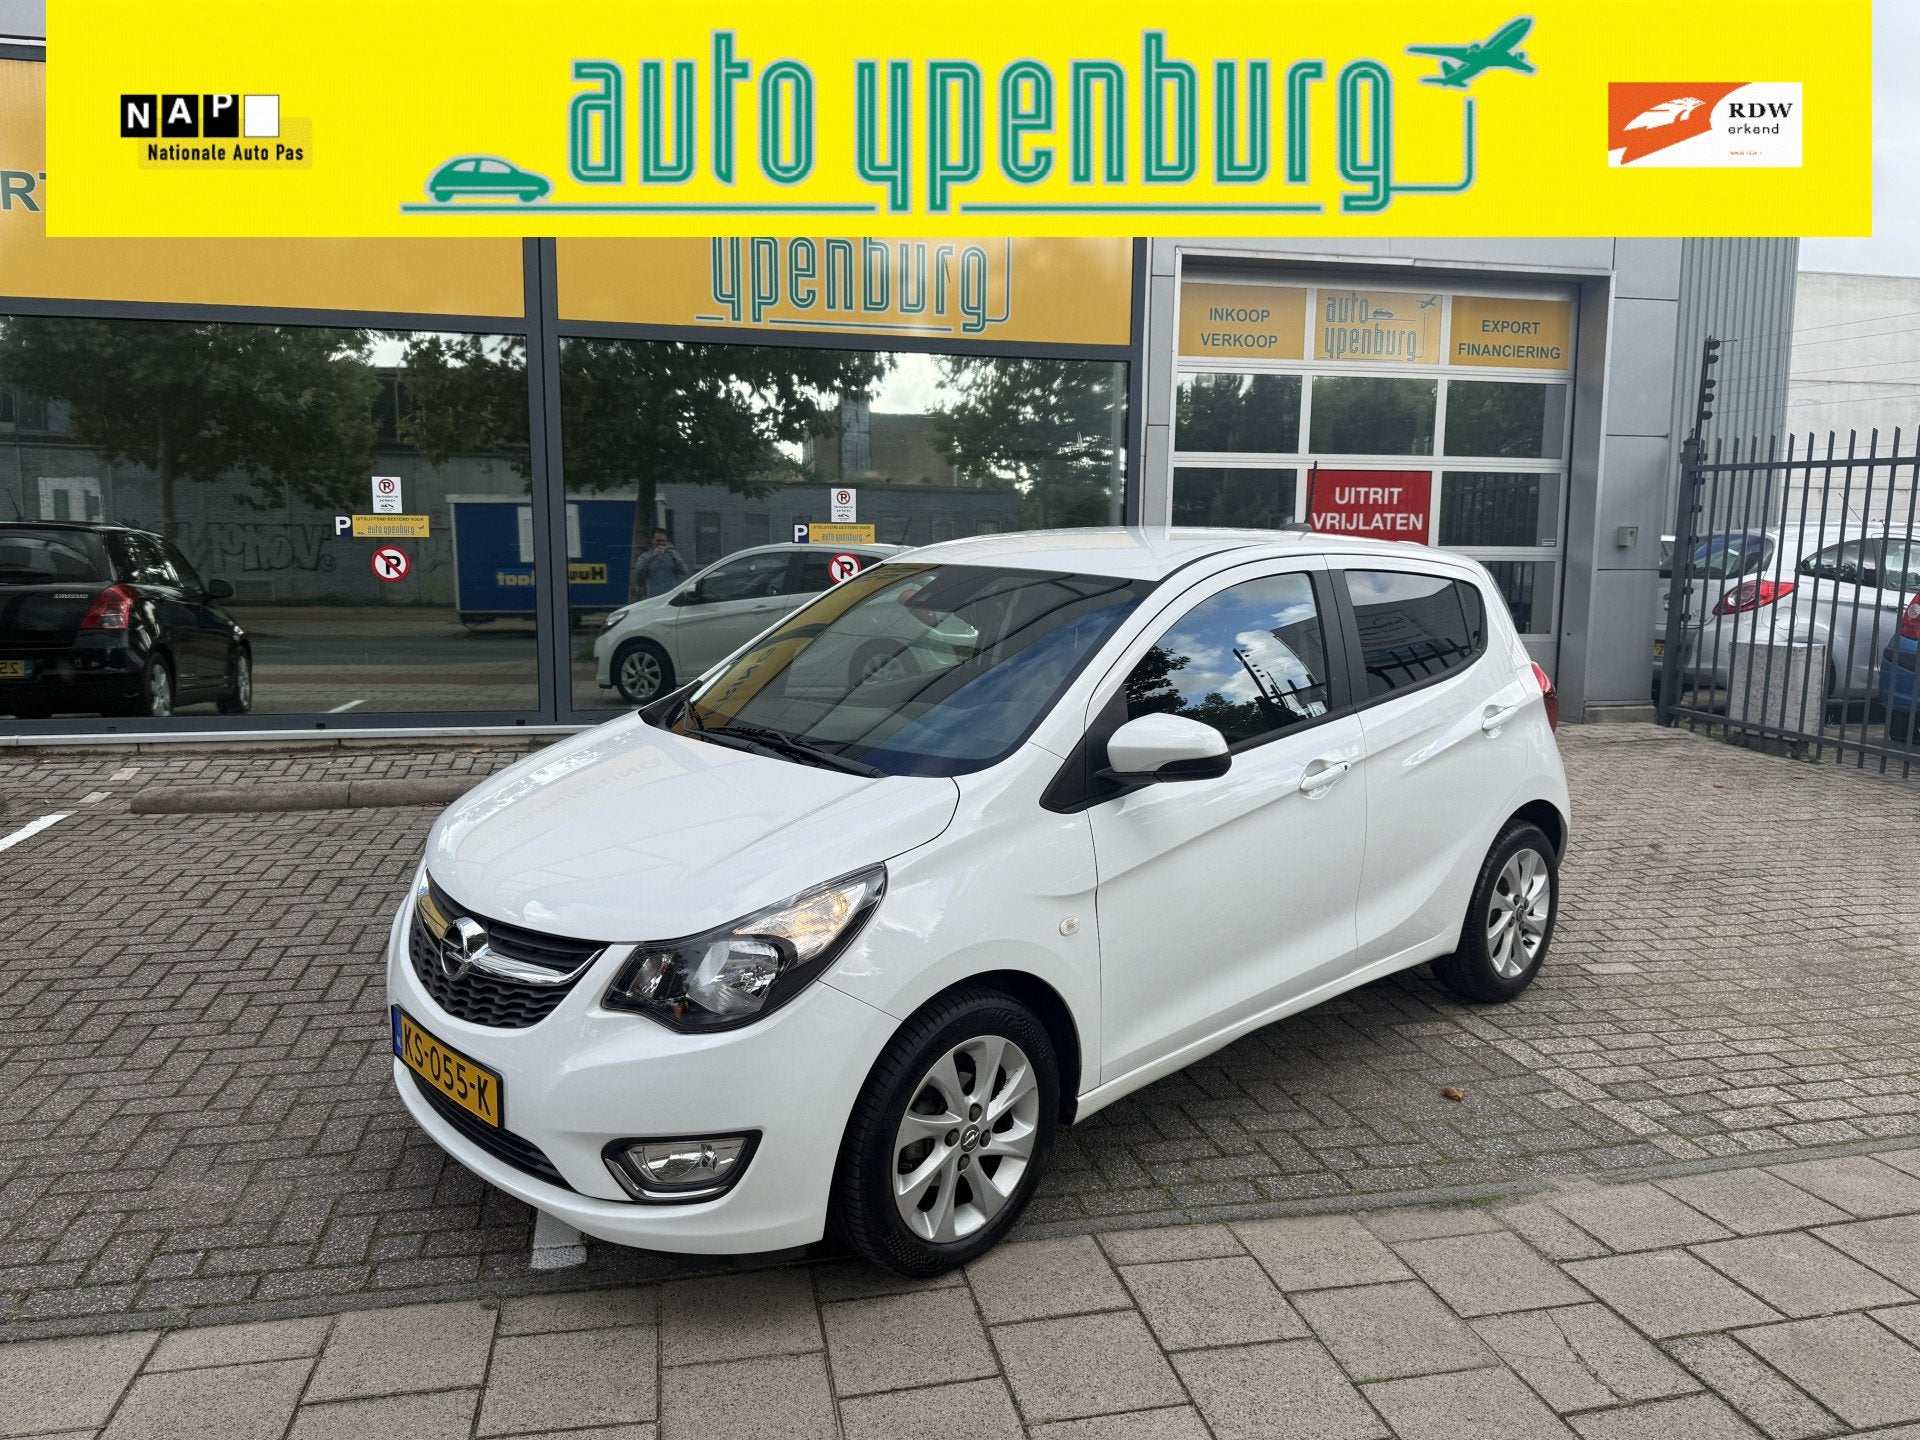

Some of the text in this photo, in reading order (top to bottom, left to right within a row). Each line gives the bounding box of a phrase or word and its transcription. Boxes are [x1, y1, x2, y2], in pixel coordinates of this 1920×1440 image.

[711, 237, 988, 333] ypenburg
[1209, 307, 1271, 323] INKOOP
[1326, 291, 1369, 324] auto
[1481, 319, 1541, 335] EXPORT
[1200, 332, 1278, 349] VERKOOP
[1325, 323, 1417, 361] ypenburg
[1458, 342, 1561, 360] FINANCIERING
[1334, 486, 1403, 506] UITRIT
[367, 525, 415, 536] auto ypenburg
[1311, 511, 1424, 532] VRIJLATEN
[404, 1022, 491, 1117] KS-055-K
